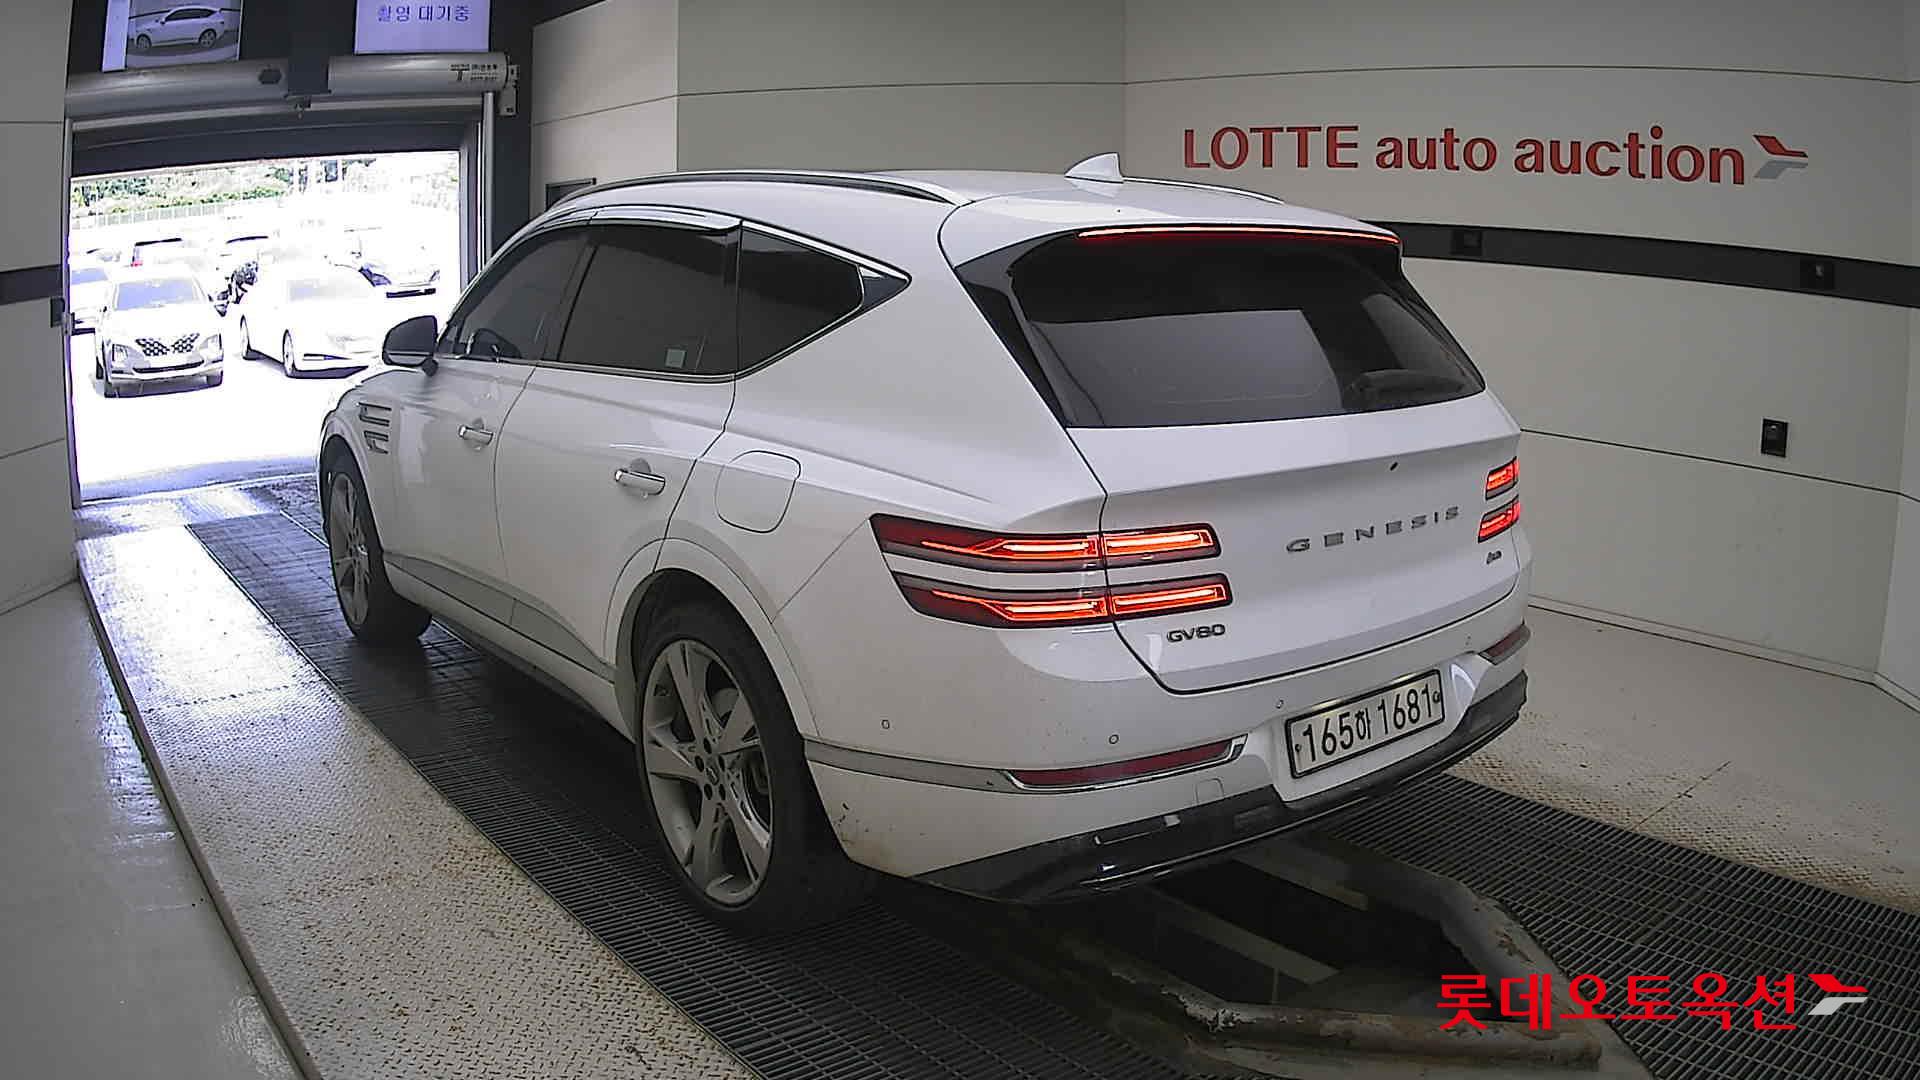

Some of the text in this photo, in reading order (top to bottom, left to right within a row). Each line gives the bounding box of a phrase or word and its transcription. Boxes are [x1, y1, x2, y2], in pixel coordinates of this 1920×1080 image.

[418, 5, 470, 23] 대기중
[1184, 125, 1745, 186] LOTTE auto auction
[1286, 506, 1459, 553] GENESIS
[1166, 623, 1226, 643] GV80
[1302, 683, 1433, 763] 165하 1681
